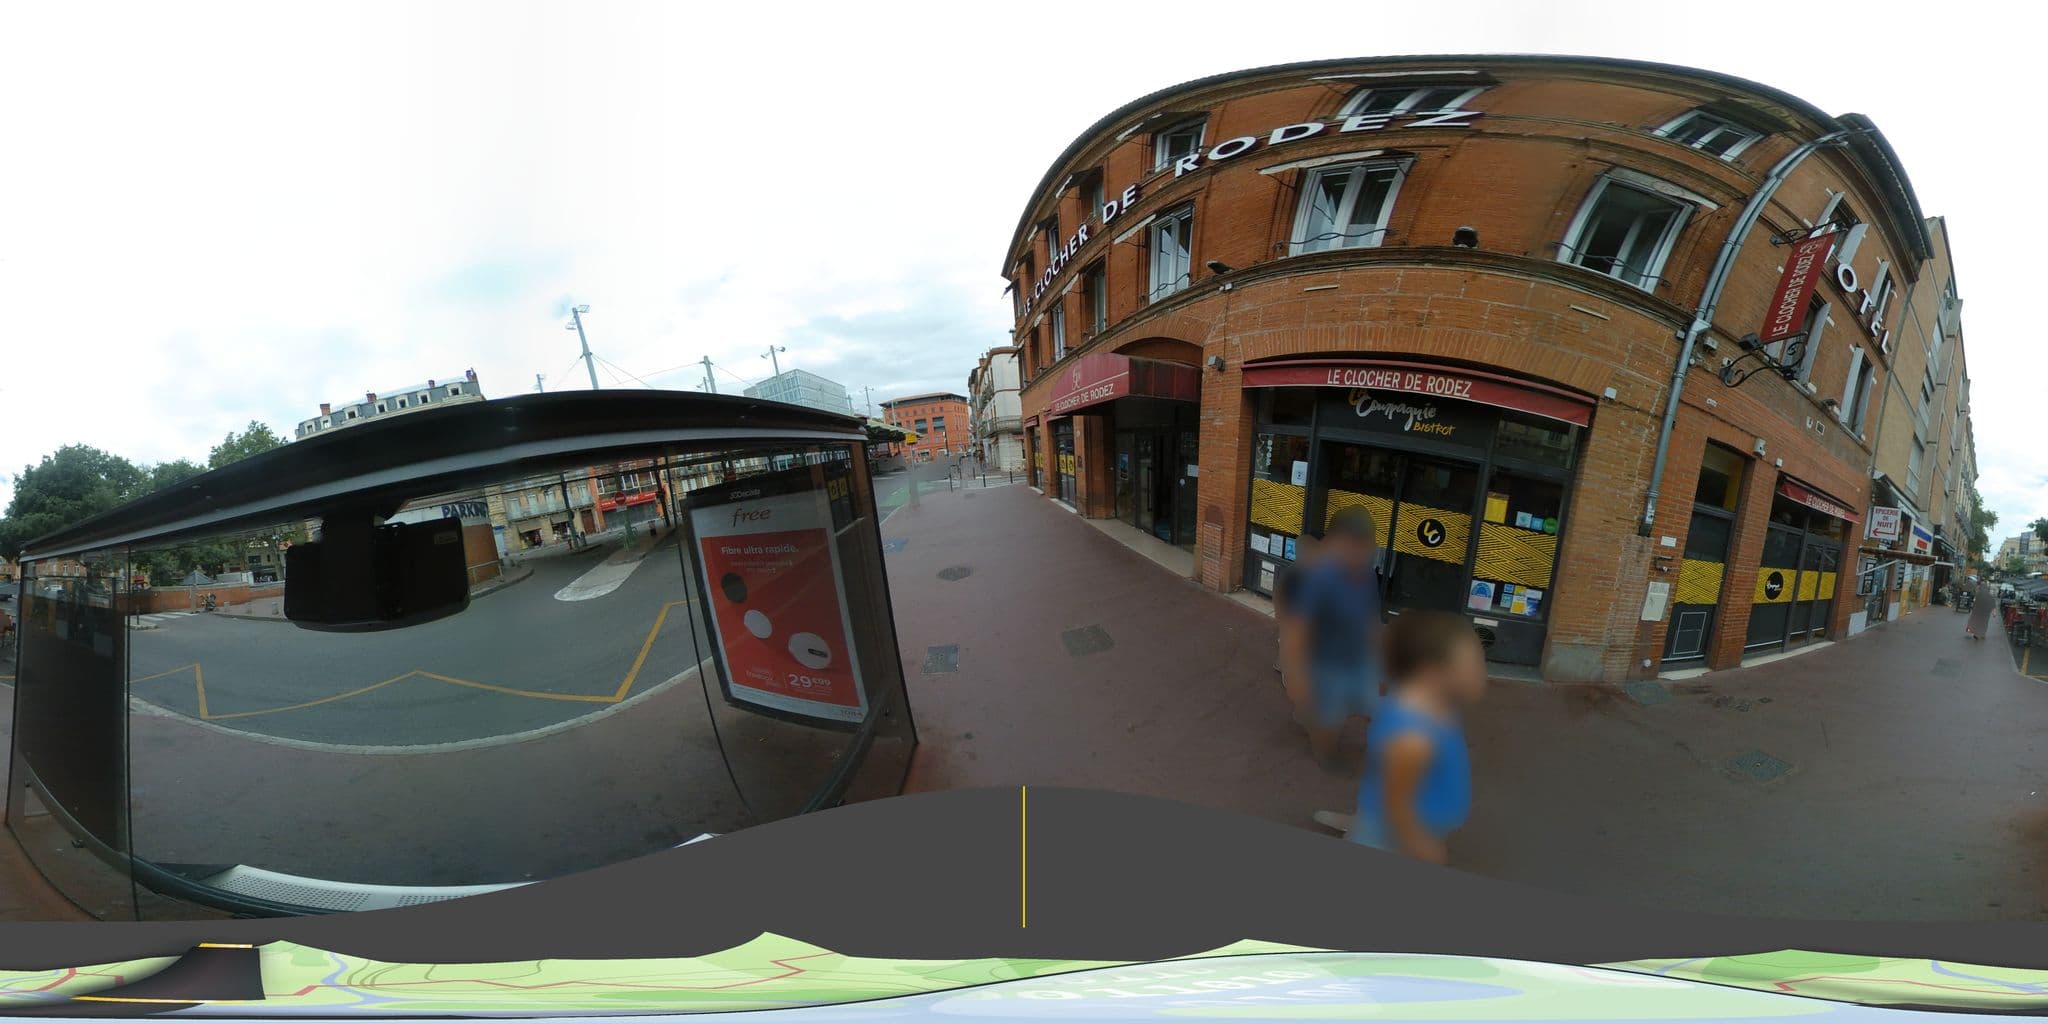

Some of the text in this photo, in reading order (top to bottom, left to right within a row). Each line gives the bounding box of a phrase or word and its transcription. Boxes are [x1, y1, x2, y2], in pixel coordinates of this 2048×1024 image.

[1034, 224, 1089, 299] CLOCHER
[1103, 184, 1137, 225] DE
[1174, 110, 1485, 179] RODEZ
[1776, 287, 1800, 325] CLOCHER
[1772, 323, 1790, 337] LE
[1081, 391, 1089, 402] DE
[1090, 383, 1114, 401] RODEZ
[1327, 367, 1473, 399] LE CLOCHER DE RODEZ
[1355, 393, 1437, 431] Compagnie
[732, 507, 771, 528] free
[1877, 520, 1893, 529] NUIT
[721, 546, 742, 555] Fibre
[743, 545, 763, 554] ultra
